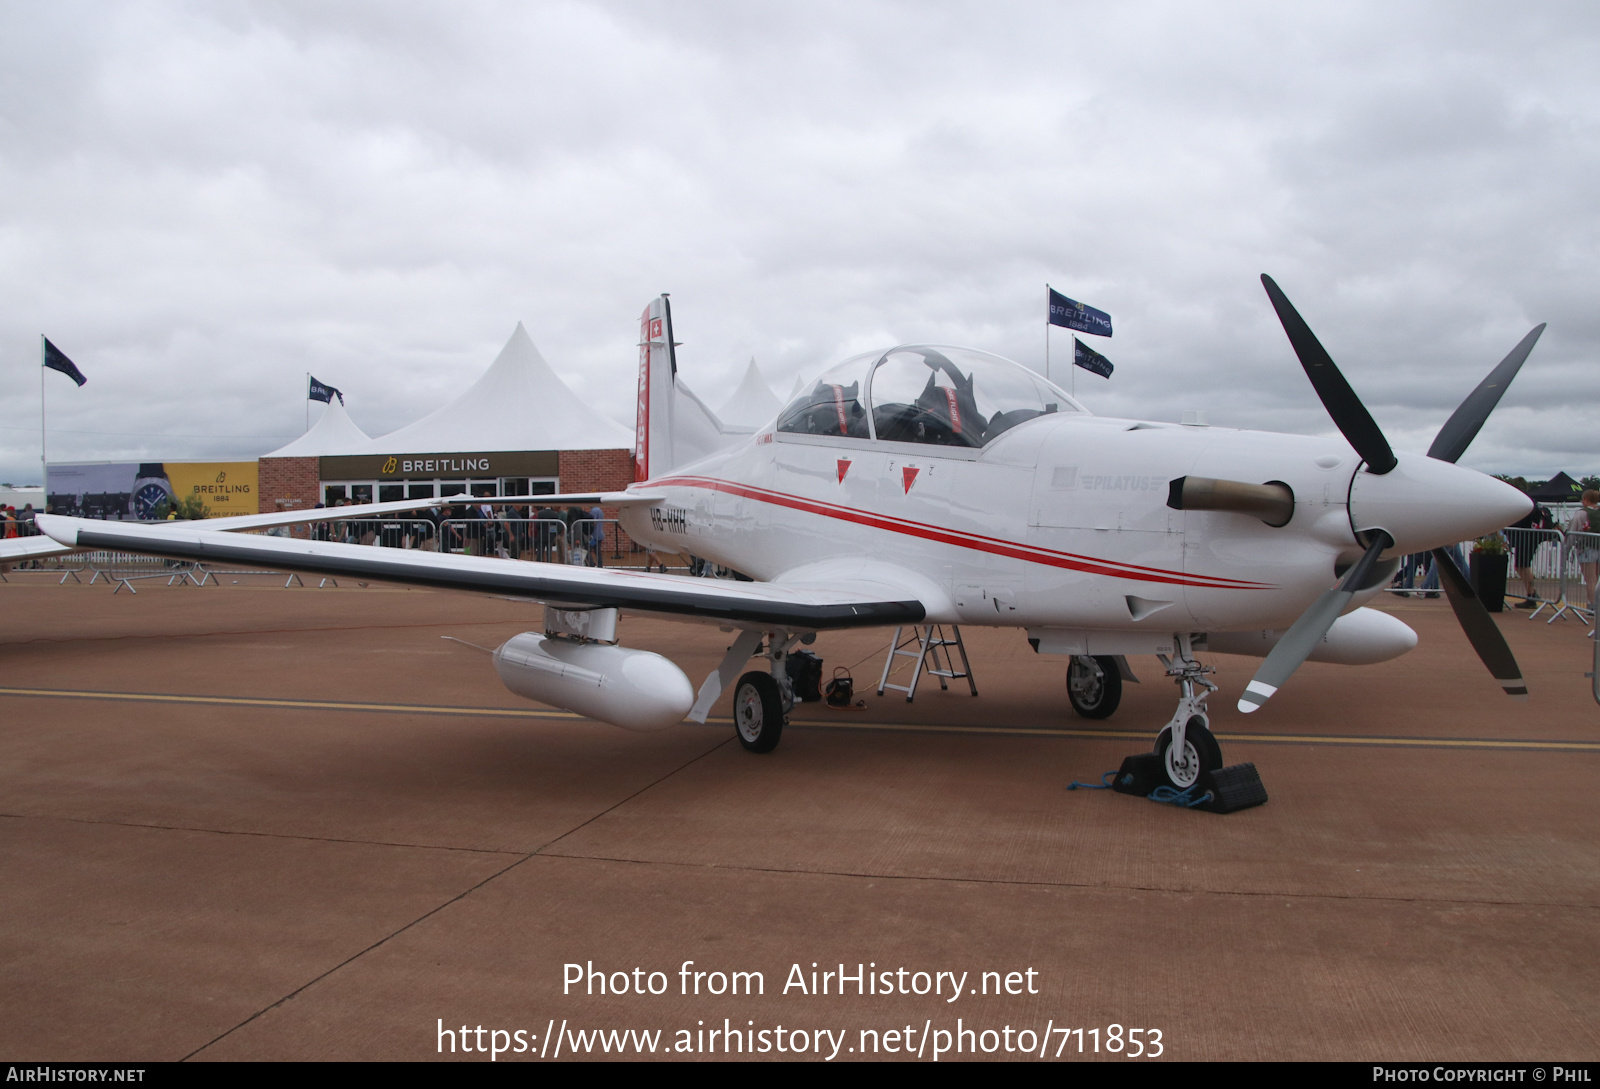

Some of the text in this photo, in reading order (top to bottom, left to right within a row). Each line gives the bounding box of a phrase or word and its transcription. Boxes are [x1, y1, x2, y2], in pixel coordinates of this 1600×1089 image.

[1050, 304, 1110, 328] BREITLING
[1068, 320, 1088, 330] 1884
[950, 401, 959, 421] FLIGHT
[402, 459, 490, 472] BREITLING
[193, 485, 250, 494] BREITLING
[1093, 475, 1150, 491] PILATUS
